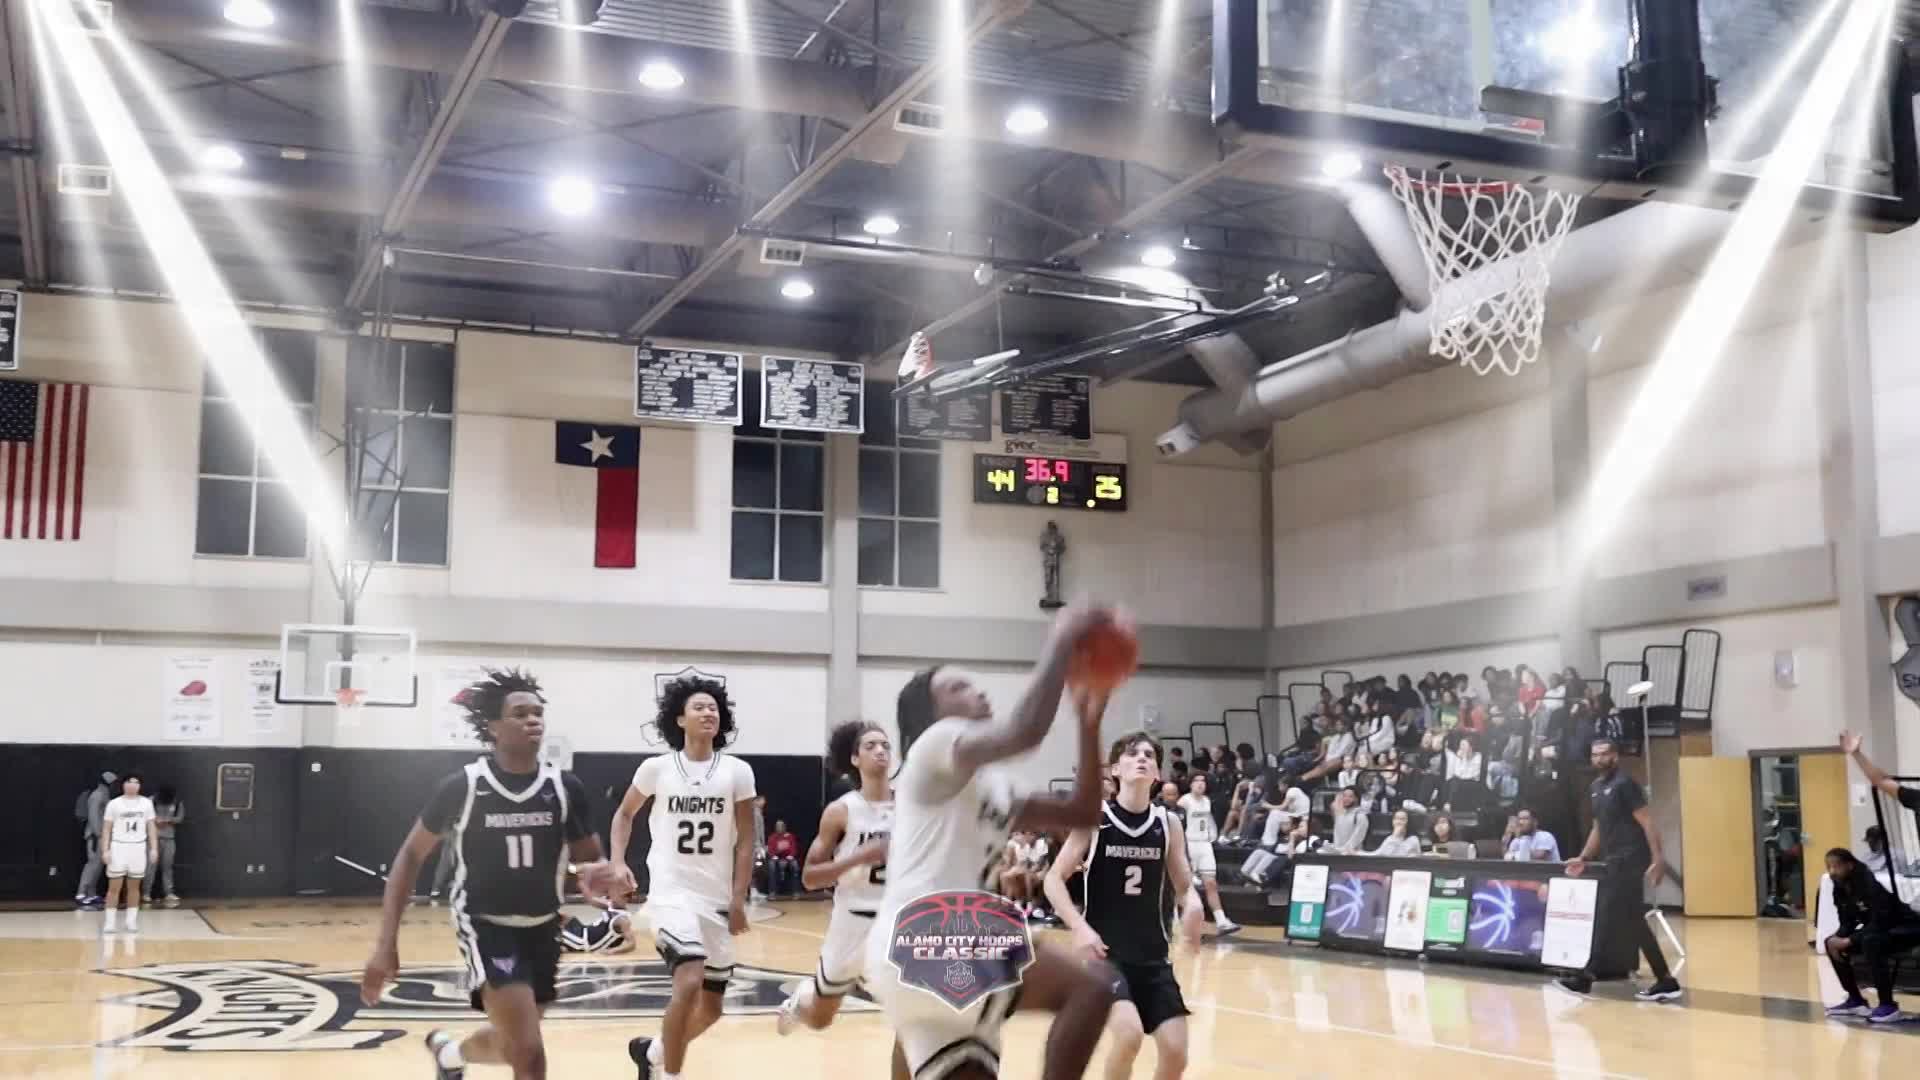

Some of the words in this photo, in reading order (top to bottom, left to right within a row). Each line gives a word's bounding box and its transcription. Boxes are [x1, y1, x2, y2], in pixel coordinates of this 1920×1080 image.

[987, 469, 1015, 492] 44
[1095, 475, 1122, 500] 25
[668, 795, 725, 814] KNIGHTS
[485, 812, 553, 828] MAVERICKS
[678, 821, 714, 854] 22
[505, 835, 533, 868] 11
[1124, 865, 1142, 896] 2
